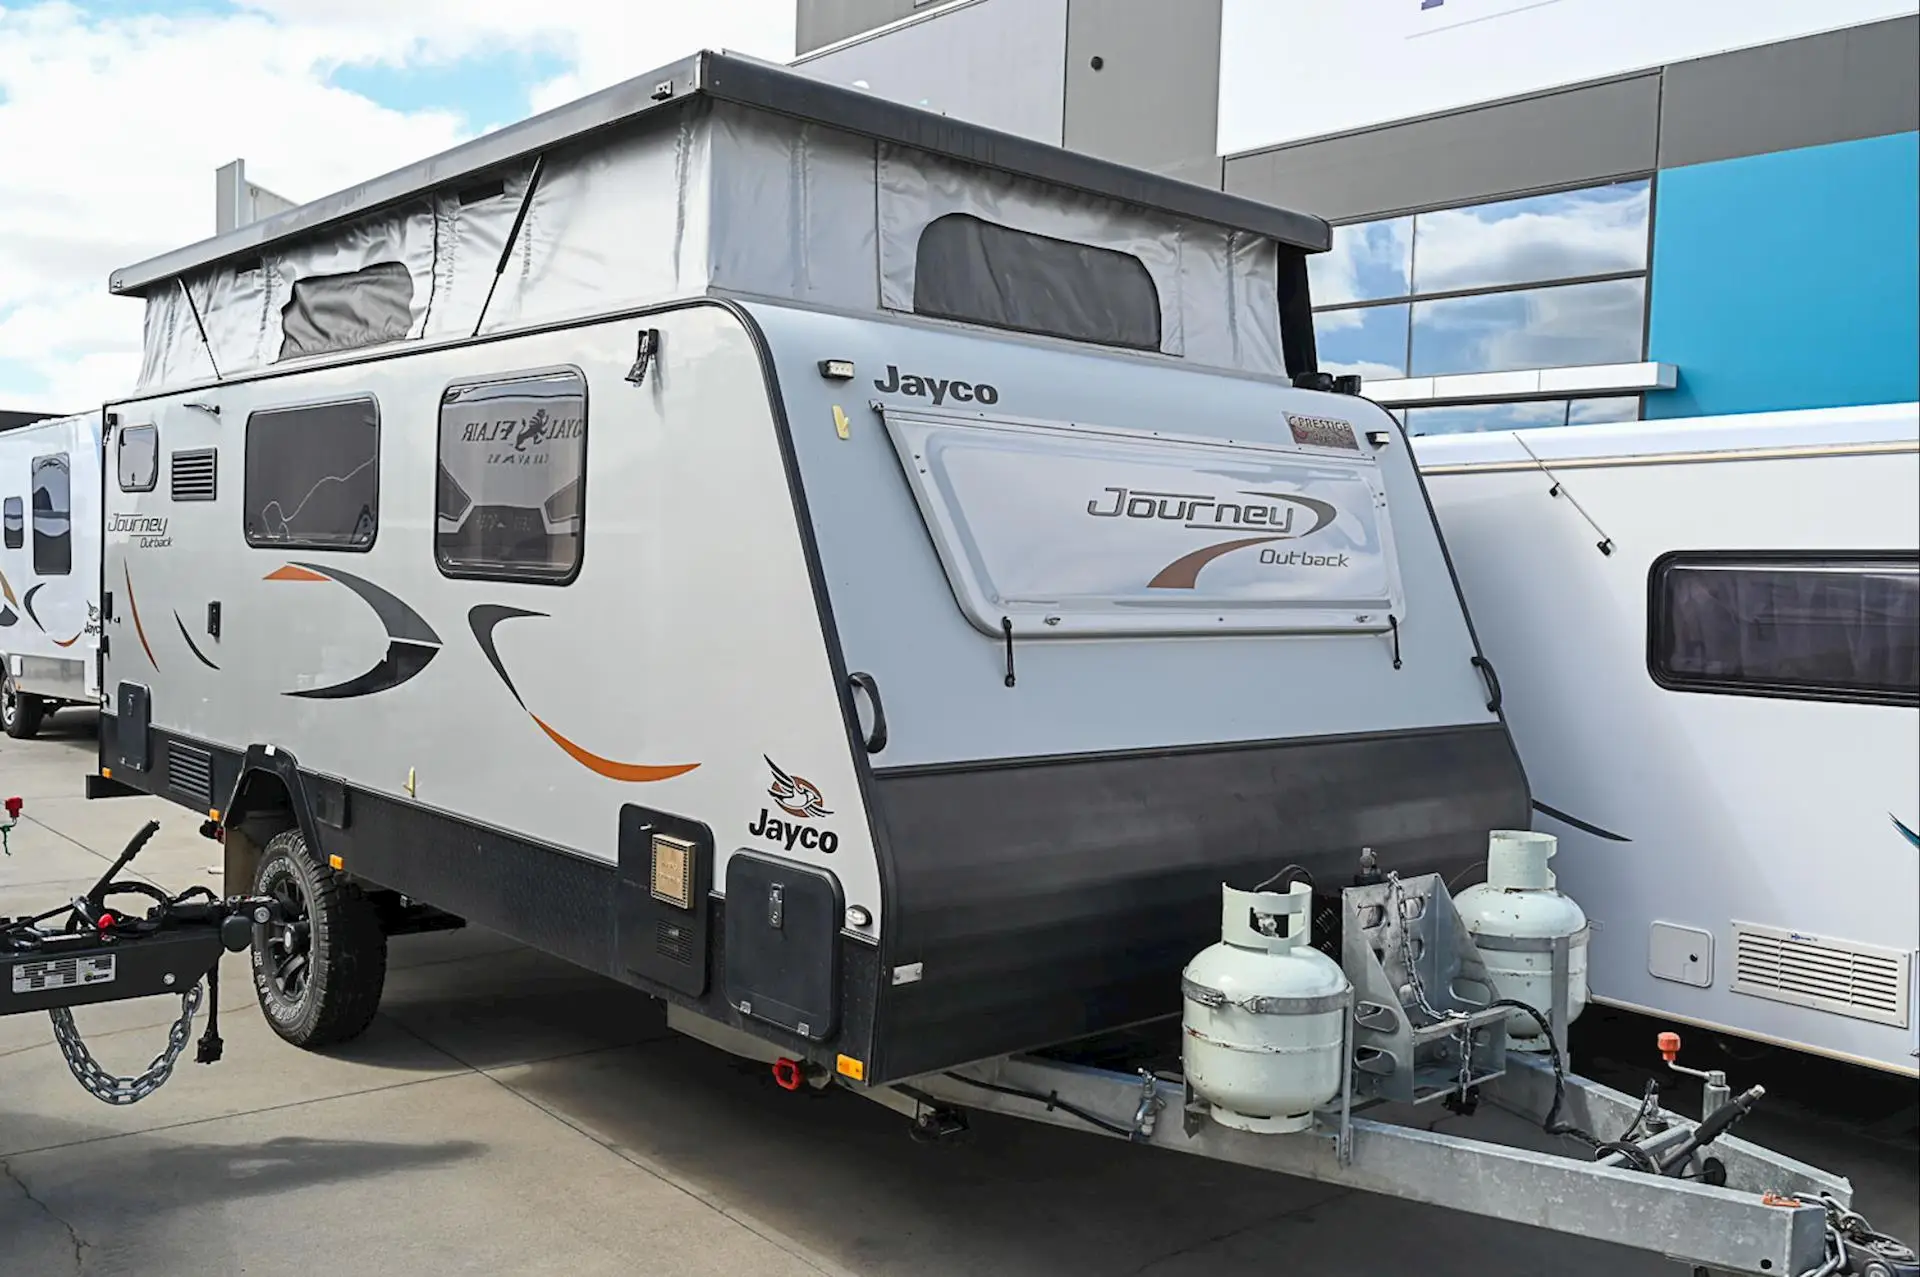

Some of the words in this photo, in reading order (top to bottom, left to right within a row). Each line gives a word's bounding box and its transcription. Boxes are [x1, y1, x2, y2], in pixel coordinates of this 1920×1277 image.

[874, 365, 999, 406] Jayco
[1297, 417, 1350, 432] PRESTIGE
[1087, 487, 1295, 532] Journey
[107, 513, 169, 537] Journey
[139, 536, 173, 548] Outback
[1258, 547, 1351, 570] Outback
[84, 621, 102, 636] Jayc
[748, 808, 839, 854] Jayco
